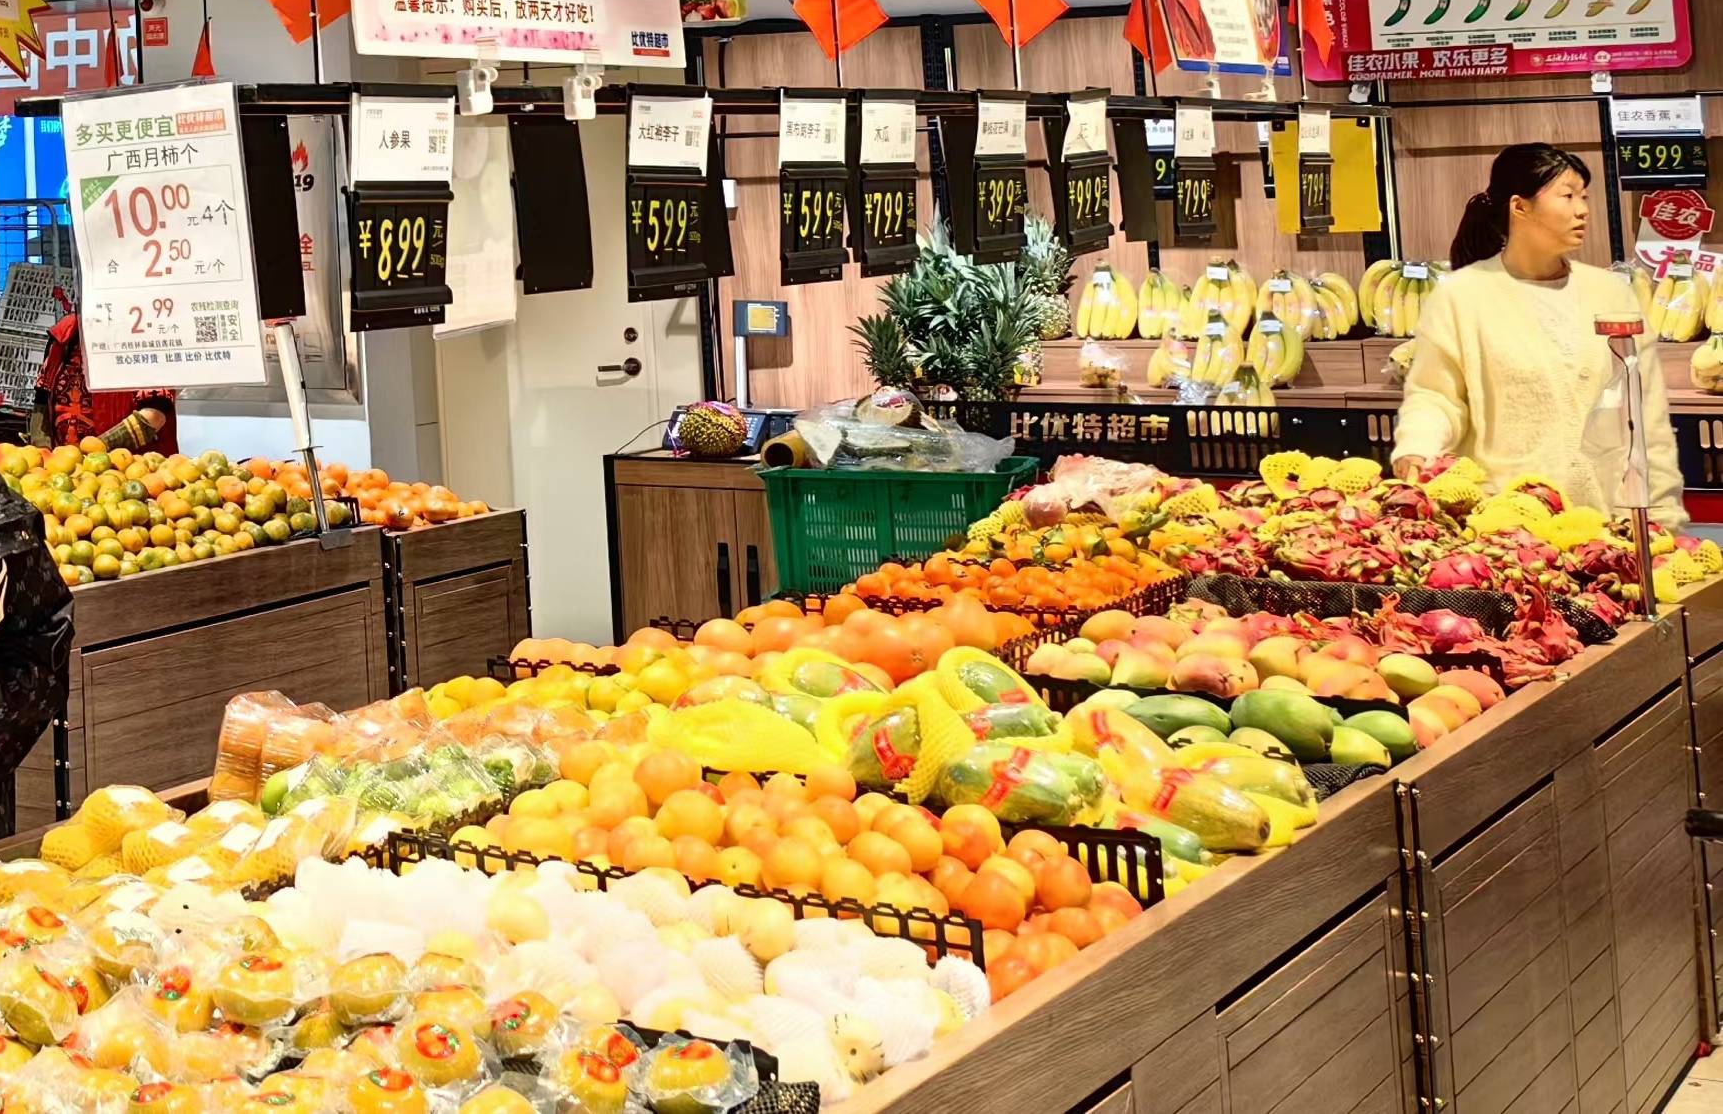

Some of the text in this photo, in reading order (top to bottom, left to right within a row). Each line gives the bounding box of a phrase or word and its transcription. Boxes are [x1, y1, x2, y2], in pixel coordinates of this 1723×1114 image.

[1433, 47, 1508, 68] 欢乐更多
[1419, 69, 1446, 78] MORE
[1449, 66, 1475, 76] THAN
[1477, 66, 1508, 75] HAPPY
[1617, 110, 1671, 122] 佳农香蕉
[76, 115, 175, 146] 多买更便宜
[378, 130, 411, 150] 人参果
[107, 143, 198, 171] 广西月柿个
[105, 183, 190, 238] 10.00
[1653, 200, 1702, 228] 佳农
[108, 239, 226, 279] 合 2.50 元/个
[128, 298, 175, 334] 2.99
[1010, 412, 1170, 444] 比优特超市
